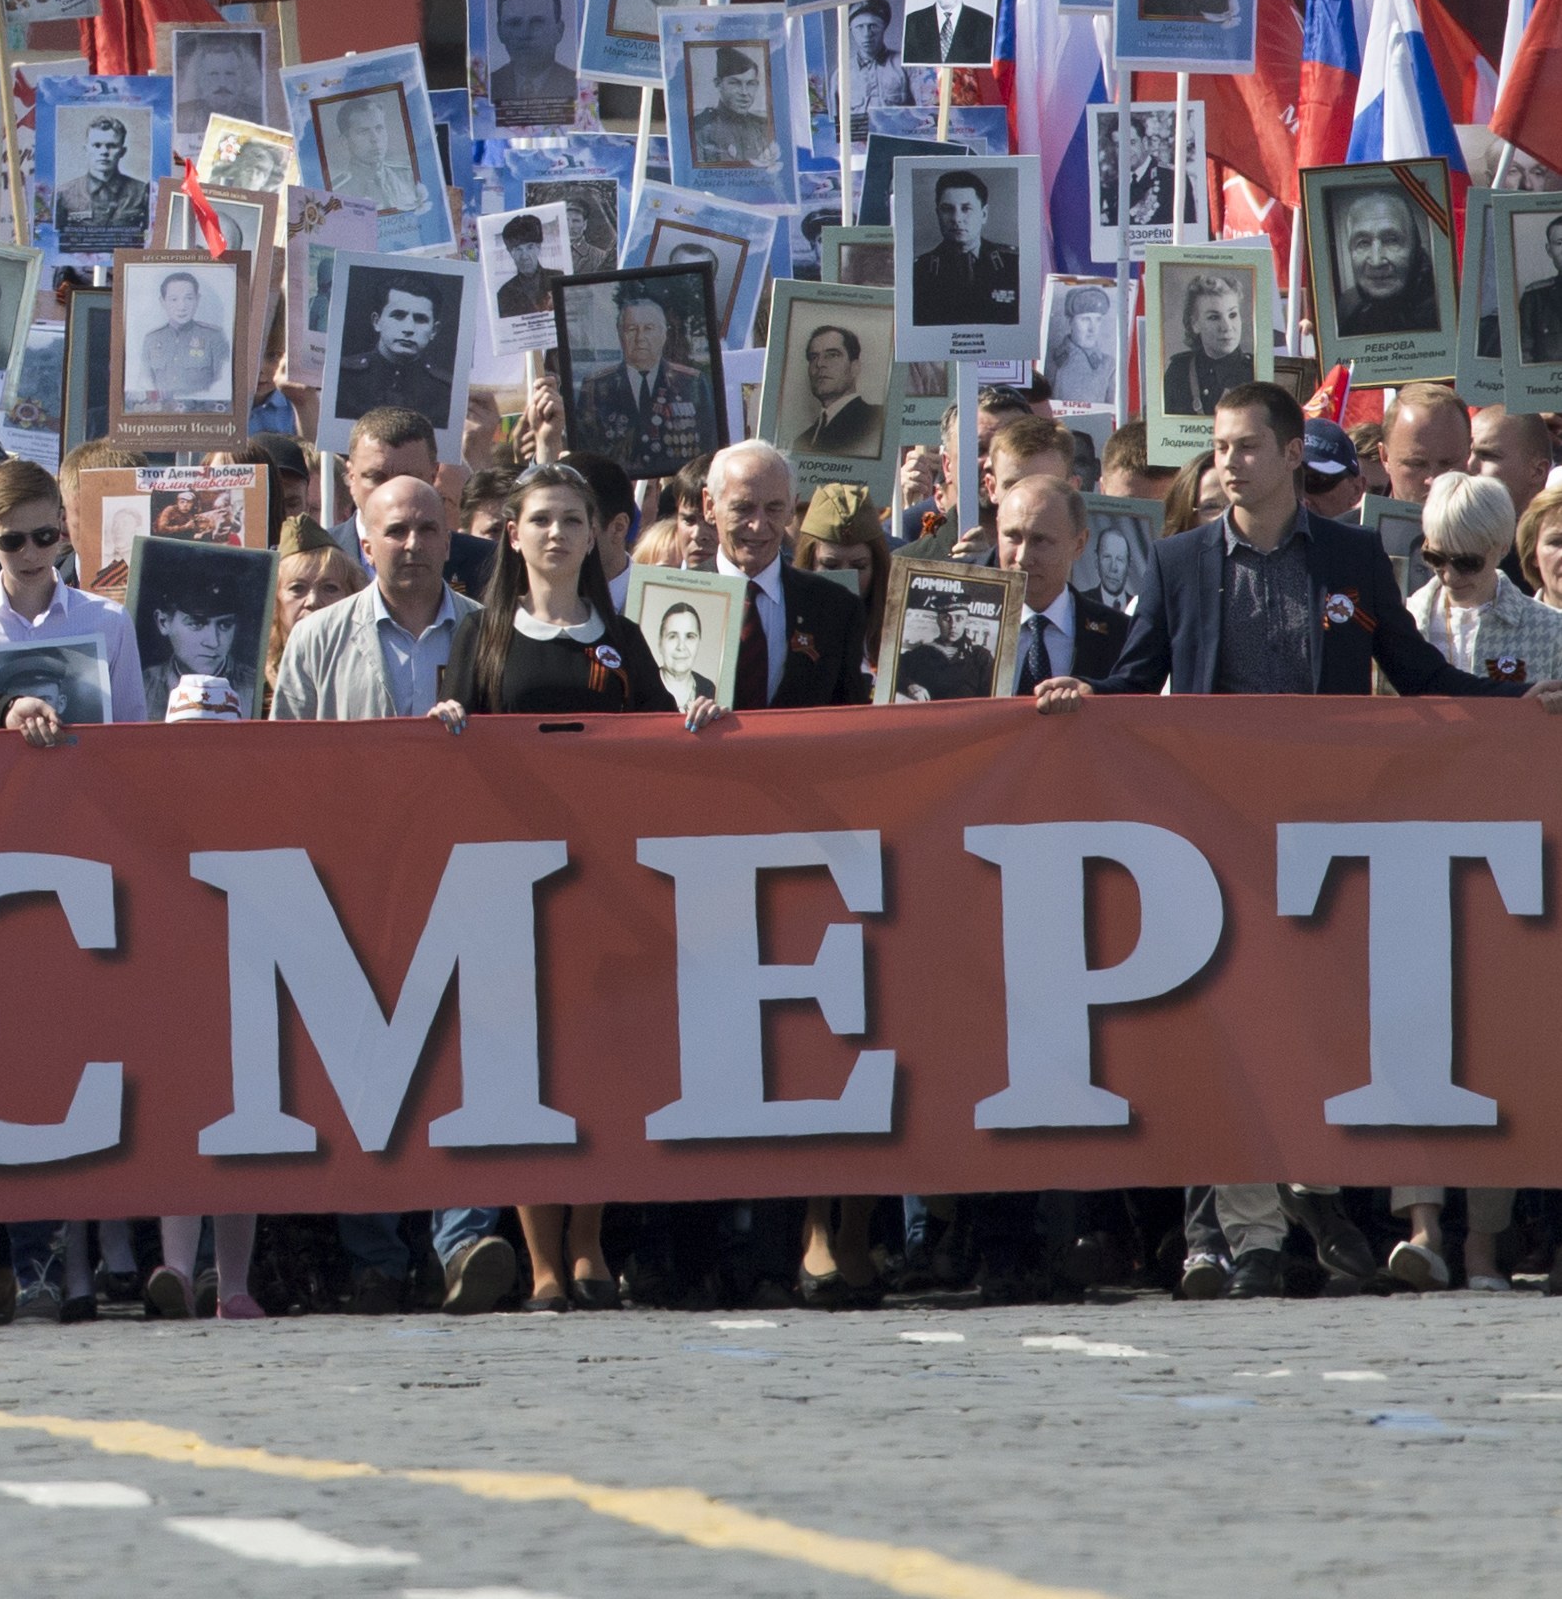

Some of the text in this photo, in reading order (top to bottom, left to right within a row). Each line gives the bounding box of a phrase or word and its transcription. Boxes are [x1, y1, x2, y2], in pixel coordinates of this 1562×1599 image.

[1364, 340, 1415, 354] РЕБРОВА
[1390, 349, 1447, 363] Яковлевна
[116, 421, 237, 438] Мирмович Иосиф
[1160, 437, 1205, 449] Людмила
[137, 467, 166, 479] Этот
[207, 466, 255, 479] Победы
[798, 460, 854, 473] КОРОВИН
